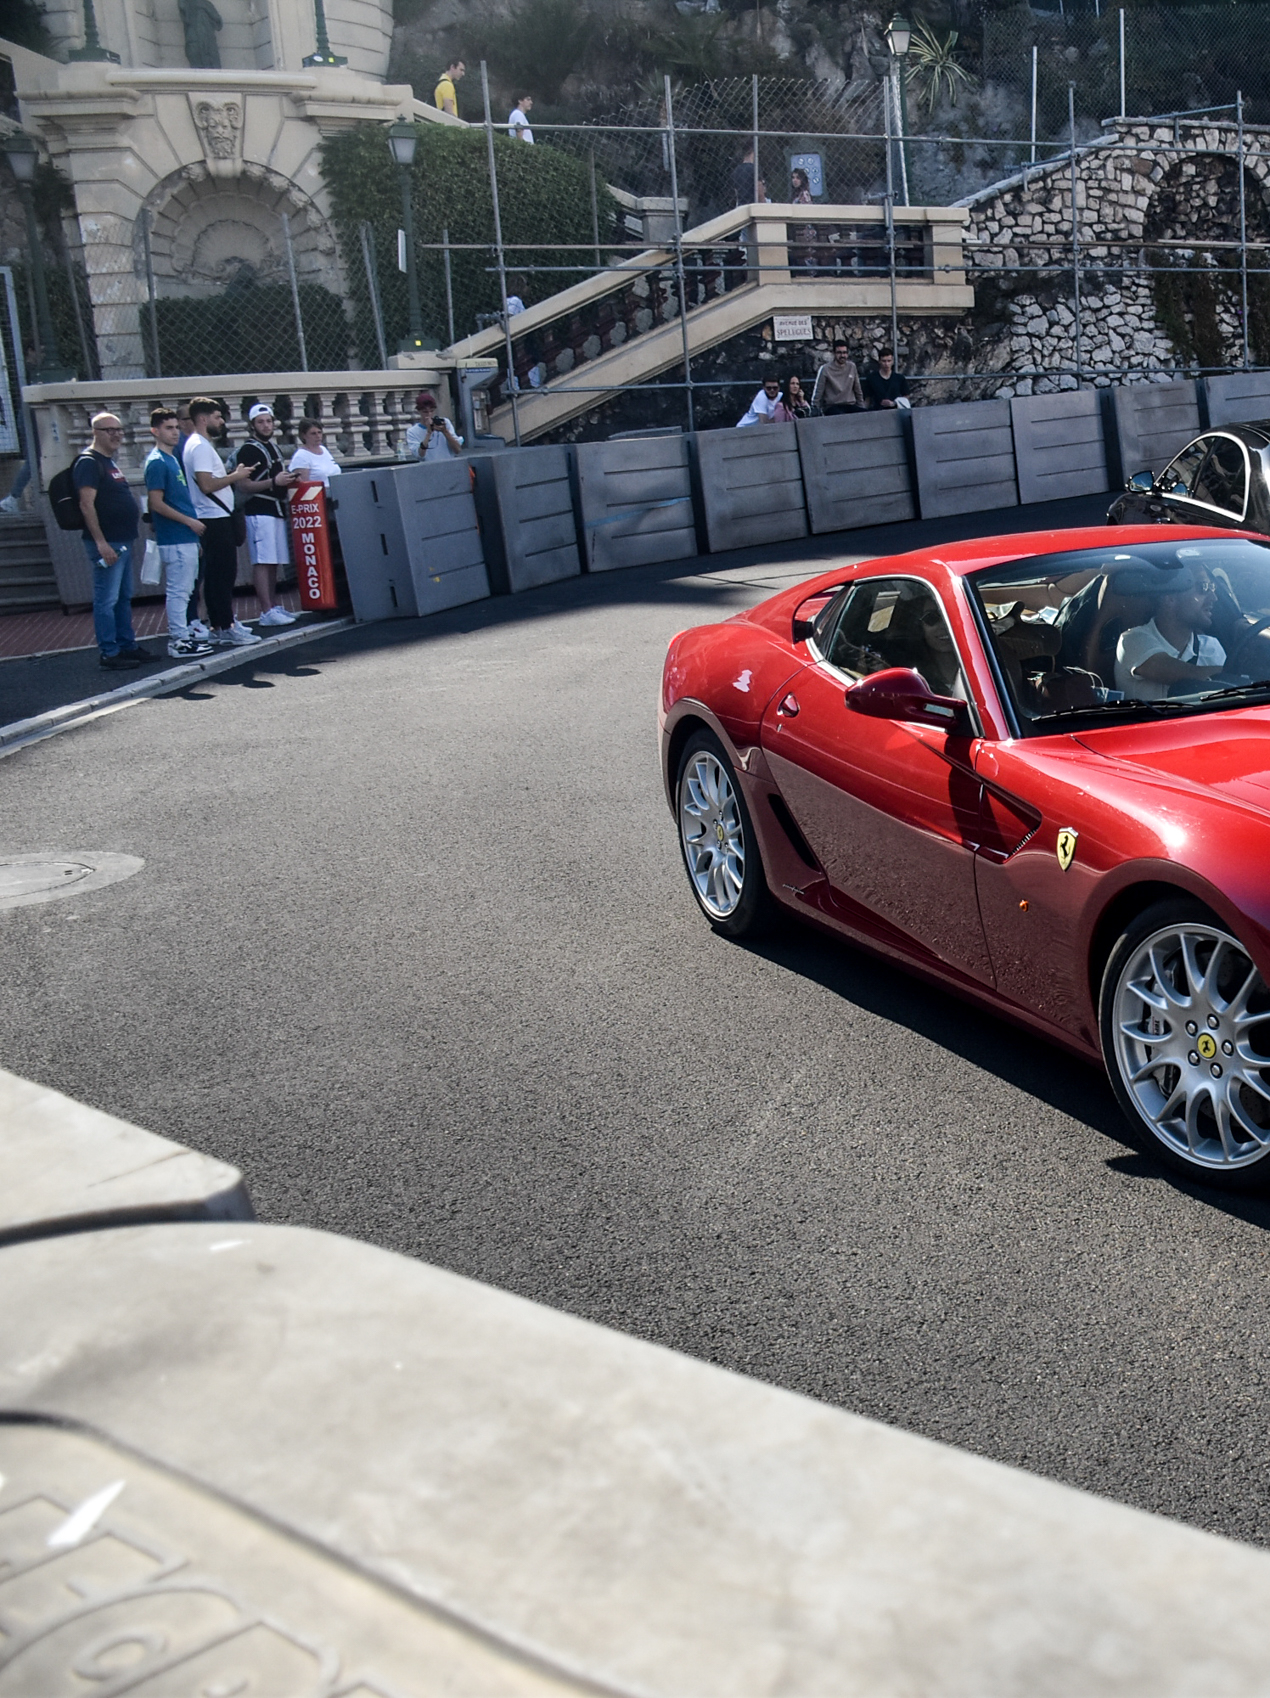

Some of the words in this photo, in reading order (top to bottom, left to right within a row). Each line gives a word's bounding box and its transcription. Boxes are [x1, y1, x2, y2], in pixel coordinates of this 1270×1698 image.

[291, 503, 319, 514] E-PRIX
[293, 516, 322, 529] 2022
[302, 532, 320, 599] MONACO
